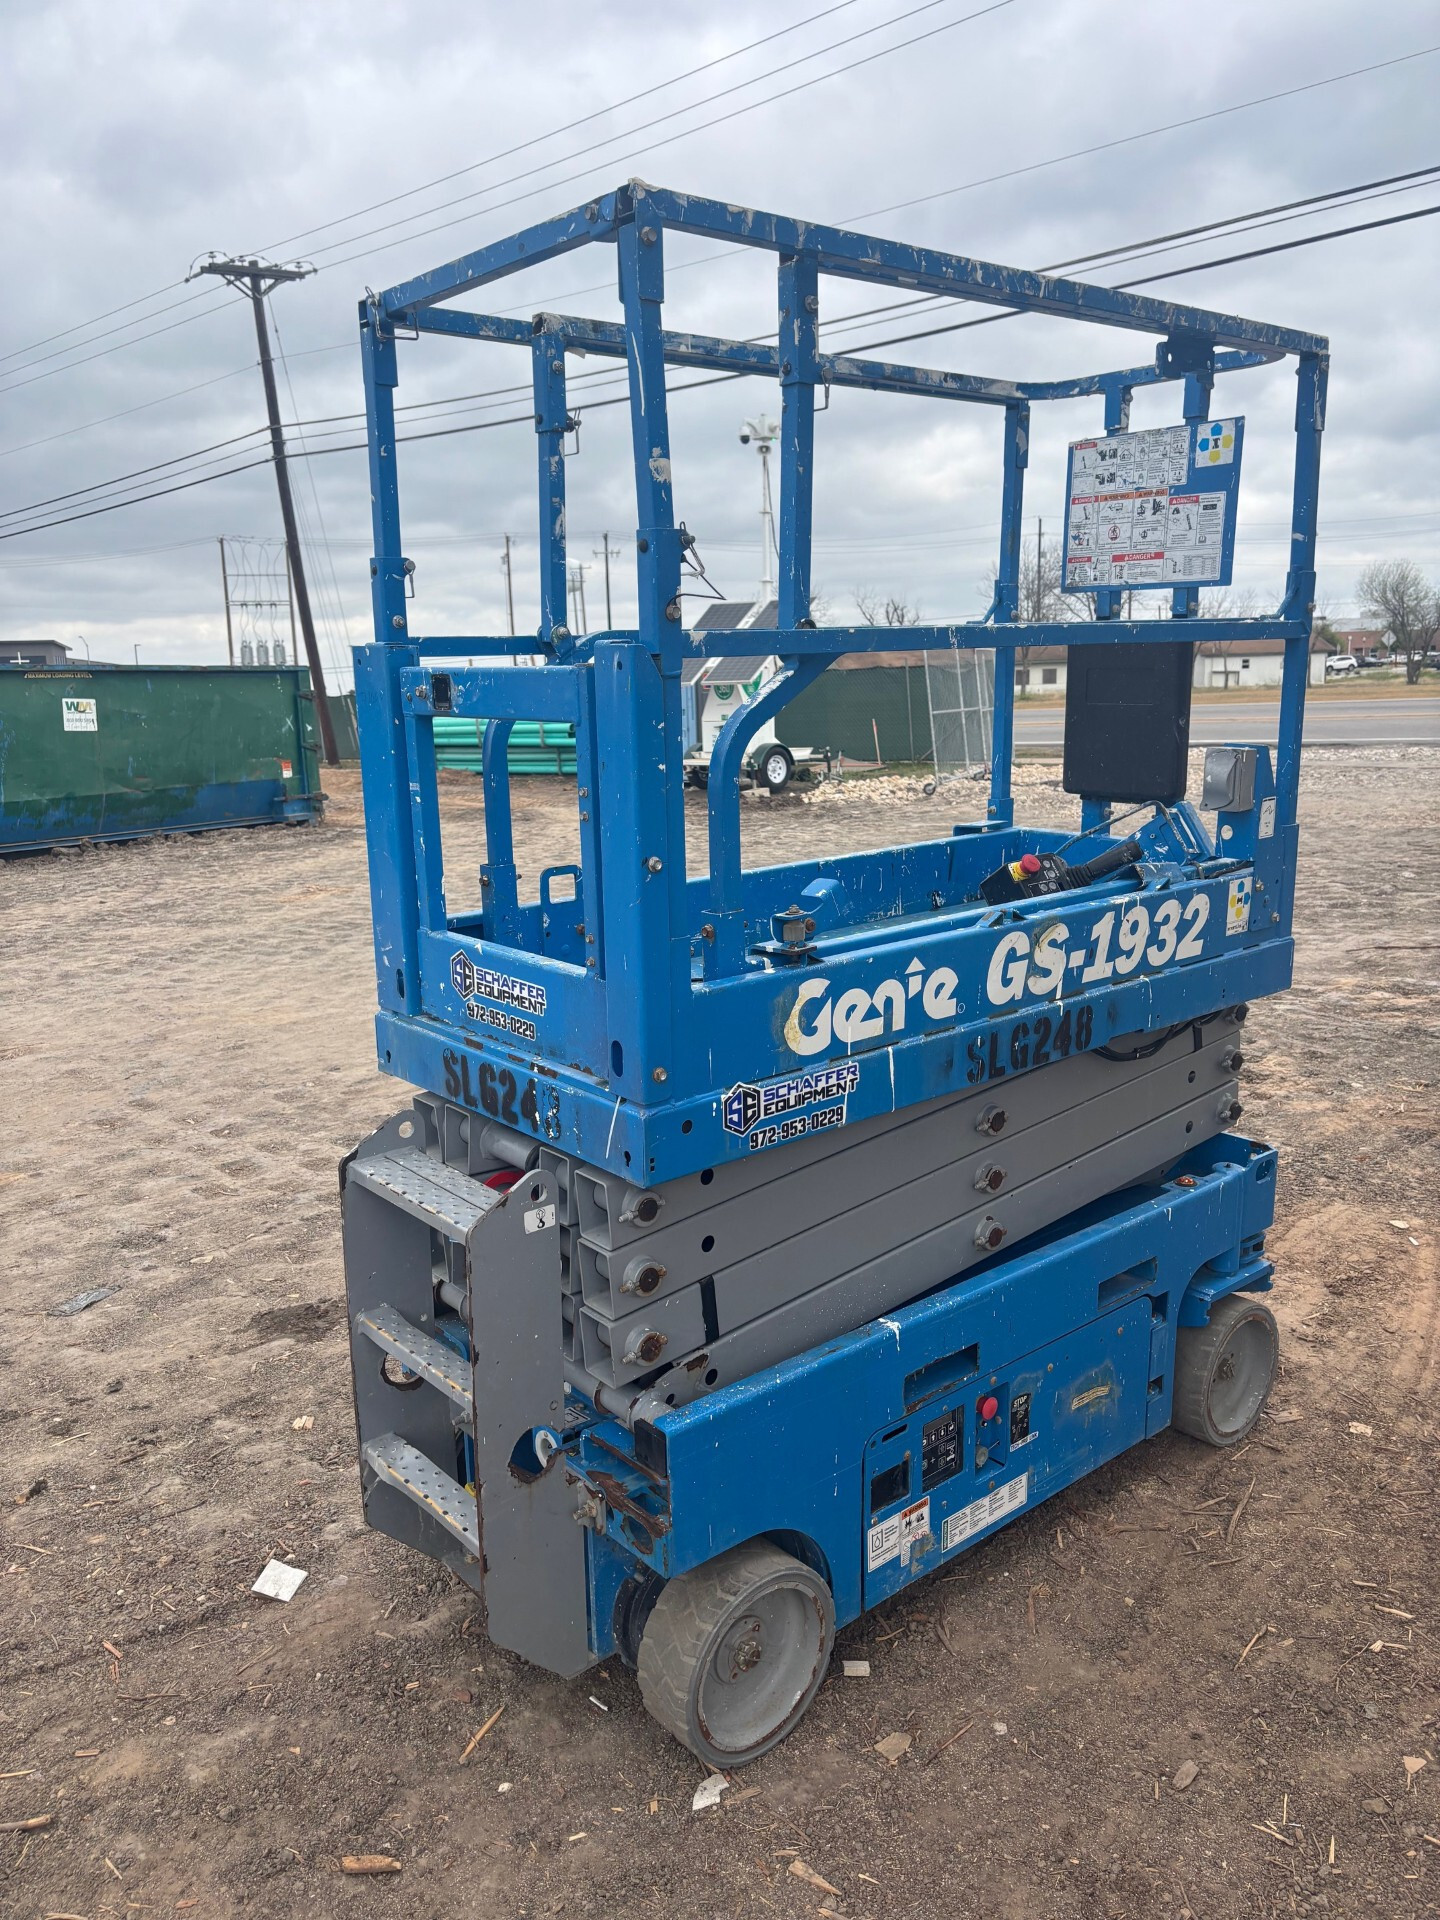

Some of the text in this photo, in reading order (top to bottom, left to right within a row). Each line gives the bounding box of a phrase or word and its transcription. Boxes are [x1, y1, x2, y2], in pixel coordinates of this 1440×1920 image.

[65, 701, 93, 713] WM
[986, 893, 1210, 1006] GS-1932
[475, 967, 546, 1002] SCHAFFER
[476, 981, 546, 1016] EQUIPMENT
[466, 1002, 536, 1040] 972-953-0229
[784, 956, 959, 1056] Genie
[967, 1005, 1094, 1084] SLG248
[443, 1047, 561, 1140] SLG248
[763, 1064, 859, 1103] SCHAFFER
[763, 1077, 859, 1118] EQUIPMENT
[749, 1105, 845, 1151] 972-953-0229
[1013, 1395, 1028, 1408] STOP
